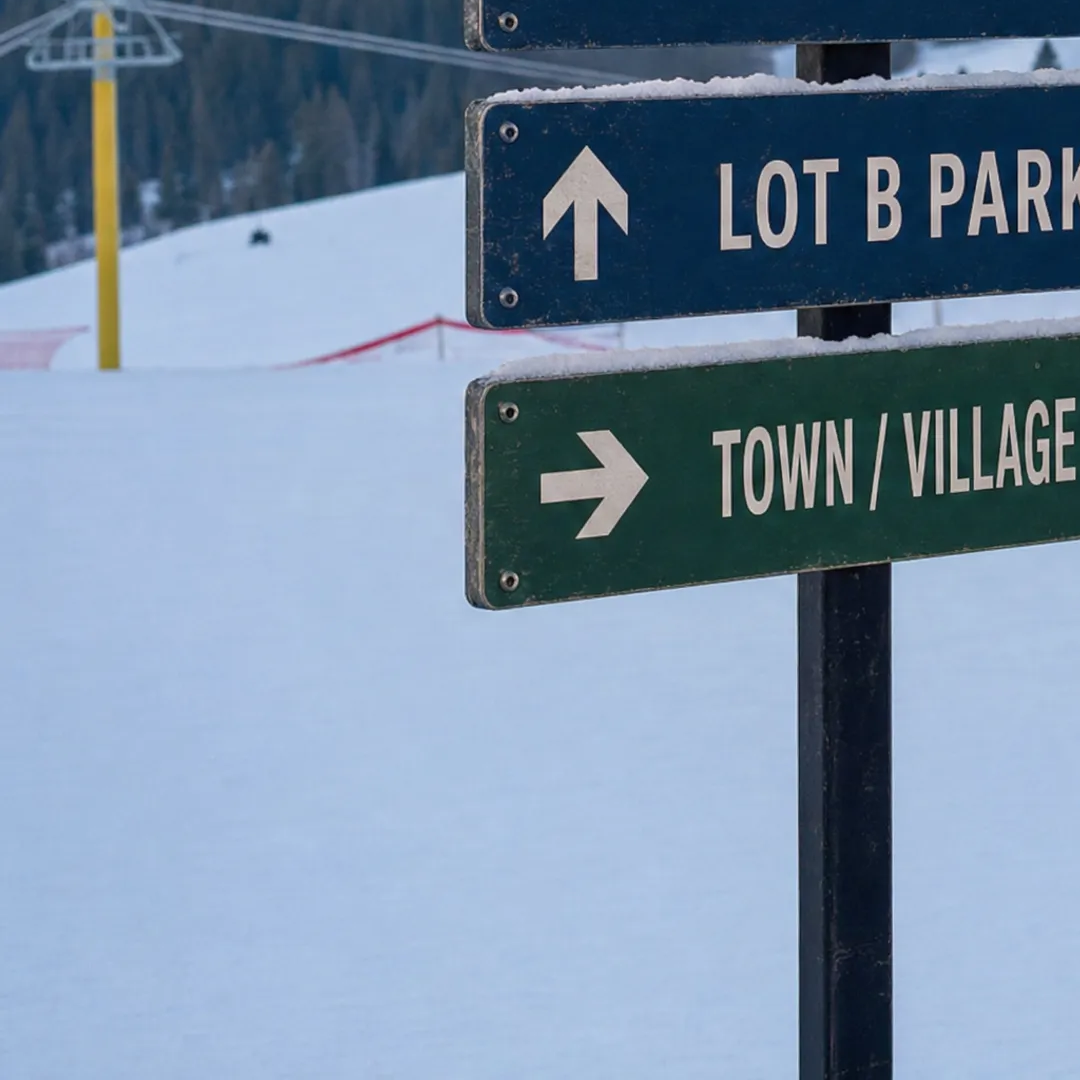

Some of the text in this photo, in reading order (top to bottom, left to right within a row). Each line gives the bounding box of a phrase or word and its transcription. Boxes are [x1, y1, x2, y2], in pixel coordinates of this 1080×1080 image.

[720, 158, 840, 251] LOT
[866, 156, 902, 242] B
[712, 418, 853, 518] TOWN
[869, 412, 888, 511] /
[902, 397, 1077, 498] VILLAGE
